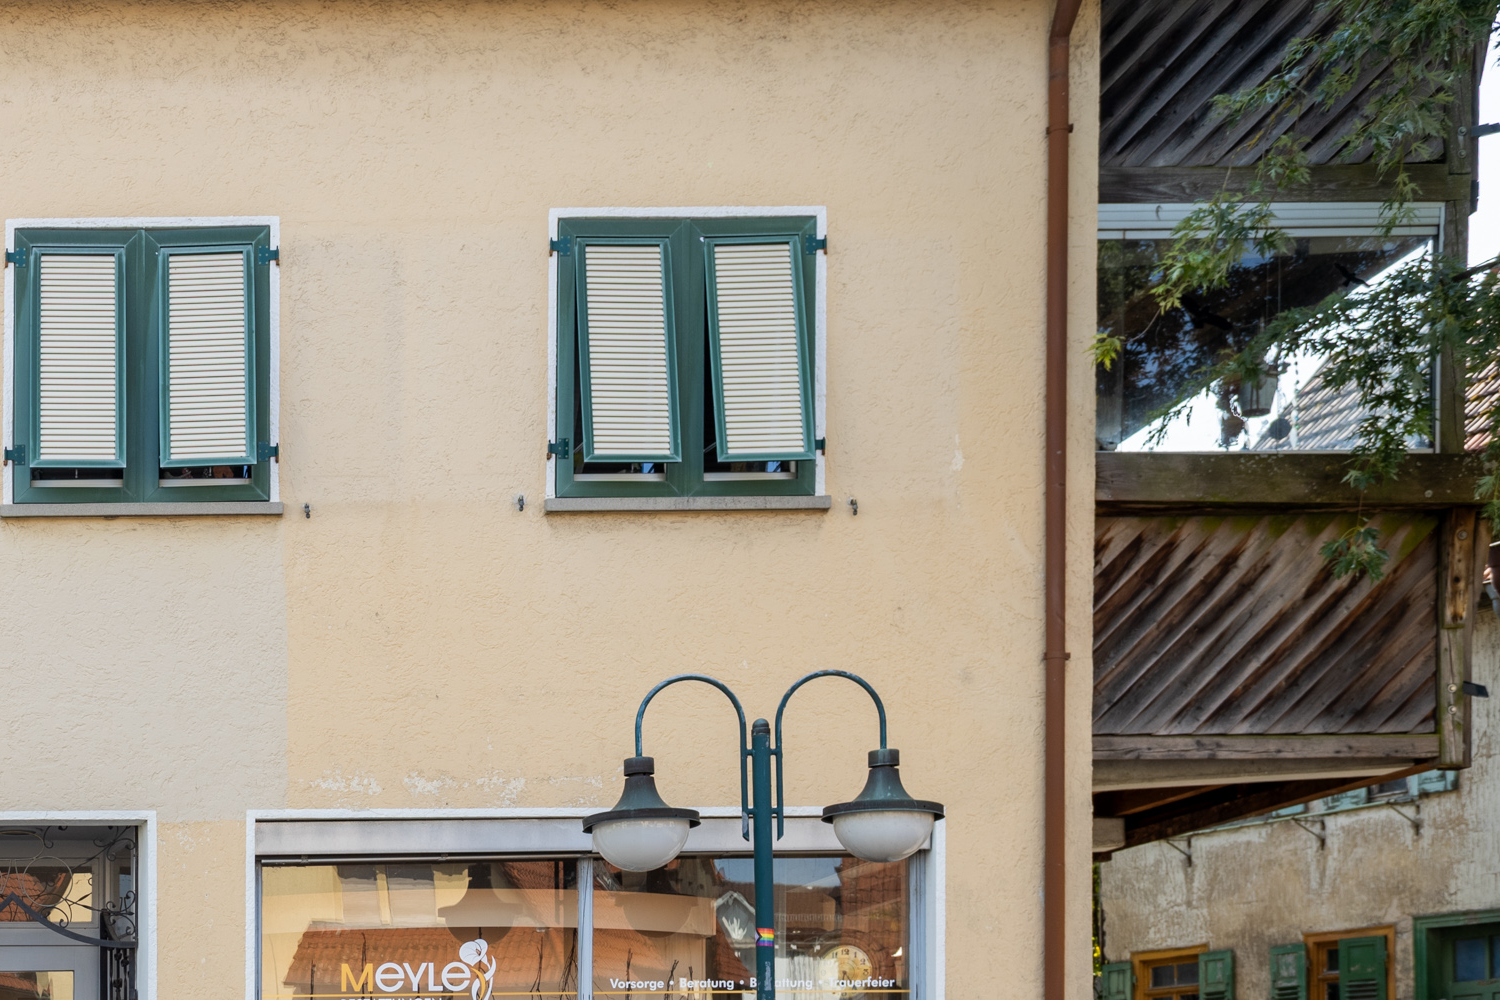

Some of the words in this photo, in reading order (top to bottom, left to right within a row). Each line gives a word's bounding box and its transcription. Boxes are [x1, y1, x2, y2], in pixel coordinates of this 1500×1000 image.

[610, 978, 664, 990] Vorsorge
[680, 977, 734, 990] Beratung
[750, 977, 813, 990] Battung
[828, 976, 895, 988] Trauerfeier
